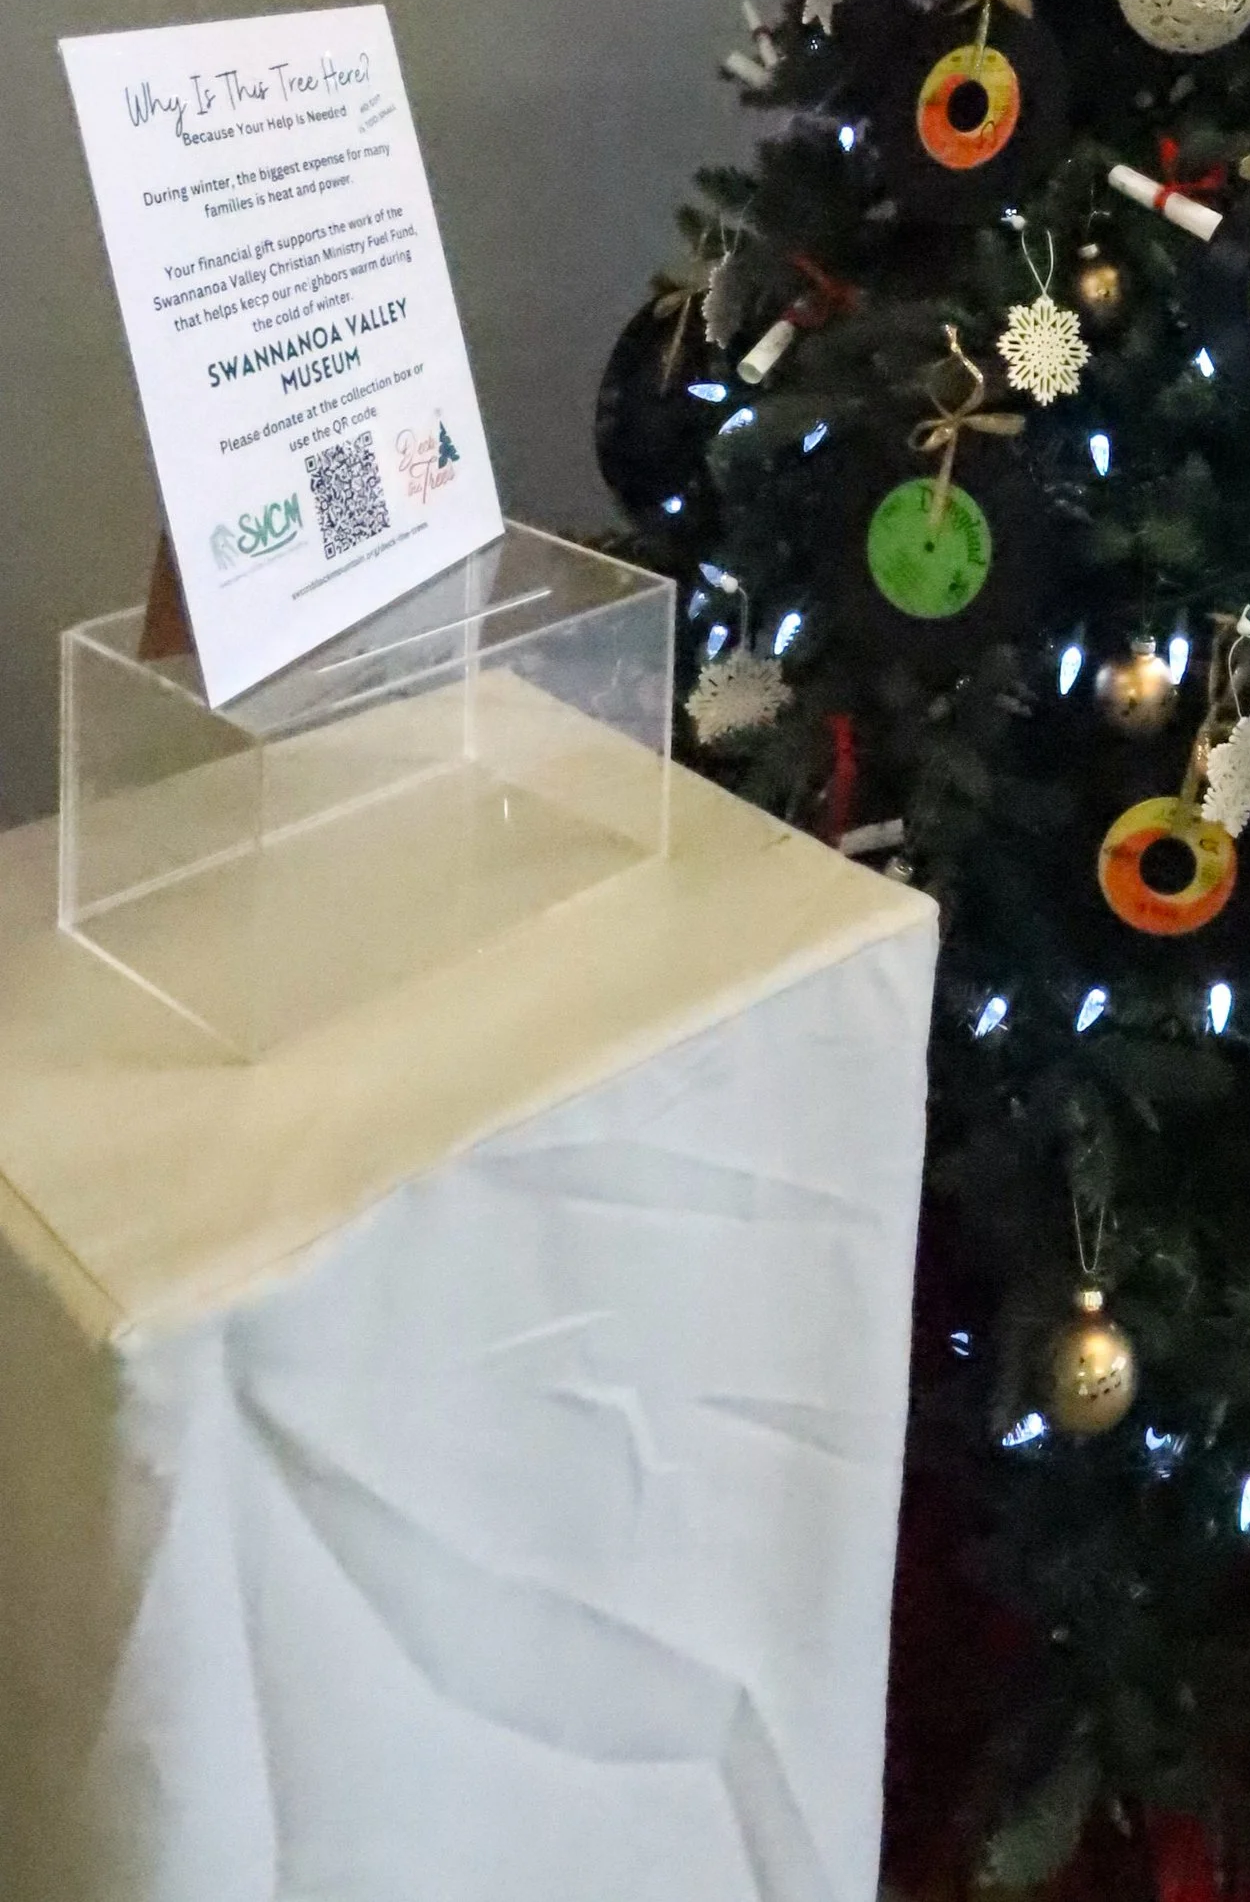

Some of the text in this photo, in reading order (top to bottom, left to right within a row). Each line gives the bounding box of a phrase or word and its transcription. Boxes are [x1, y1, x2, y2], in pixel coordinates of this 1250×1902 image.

[125, 51, 370, 138] Why Is This Tree Here?
[182, 125, 235, 146] Because
[236, 120, 264, 135] Your
[267, 114, 294, 132] Help
[306, 104, 347, 123] Needed
[143, 143, 390, 207] During winter, the biggest expense for many
[204, 174, 353, 219] families is heat and power.
[153, 224, 418, 312] Swannanoa Valley Christian Ministry Fuel Fund,
[164, 206, 404, 281] Your financial gift supports the work of the
[174, 249, 412, 332] that helps keep our neighbors warm during
[252, 291, 354, 333] the cold of winter.
[207, 297, 408, 388] SWANNANOA VALLEY
[280, 346, 362, 395] MUSEUM
[219, 362, 425, 454] Please donate at the collection box or
[289, 405, 378, 452] use the QR code
[237, 492, 304, 554] SVCM
